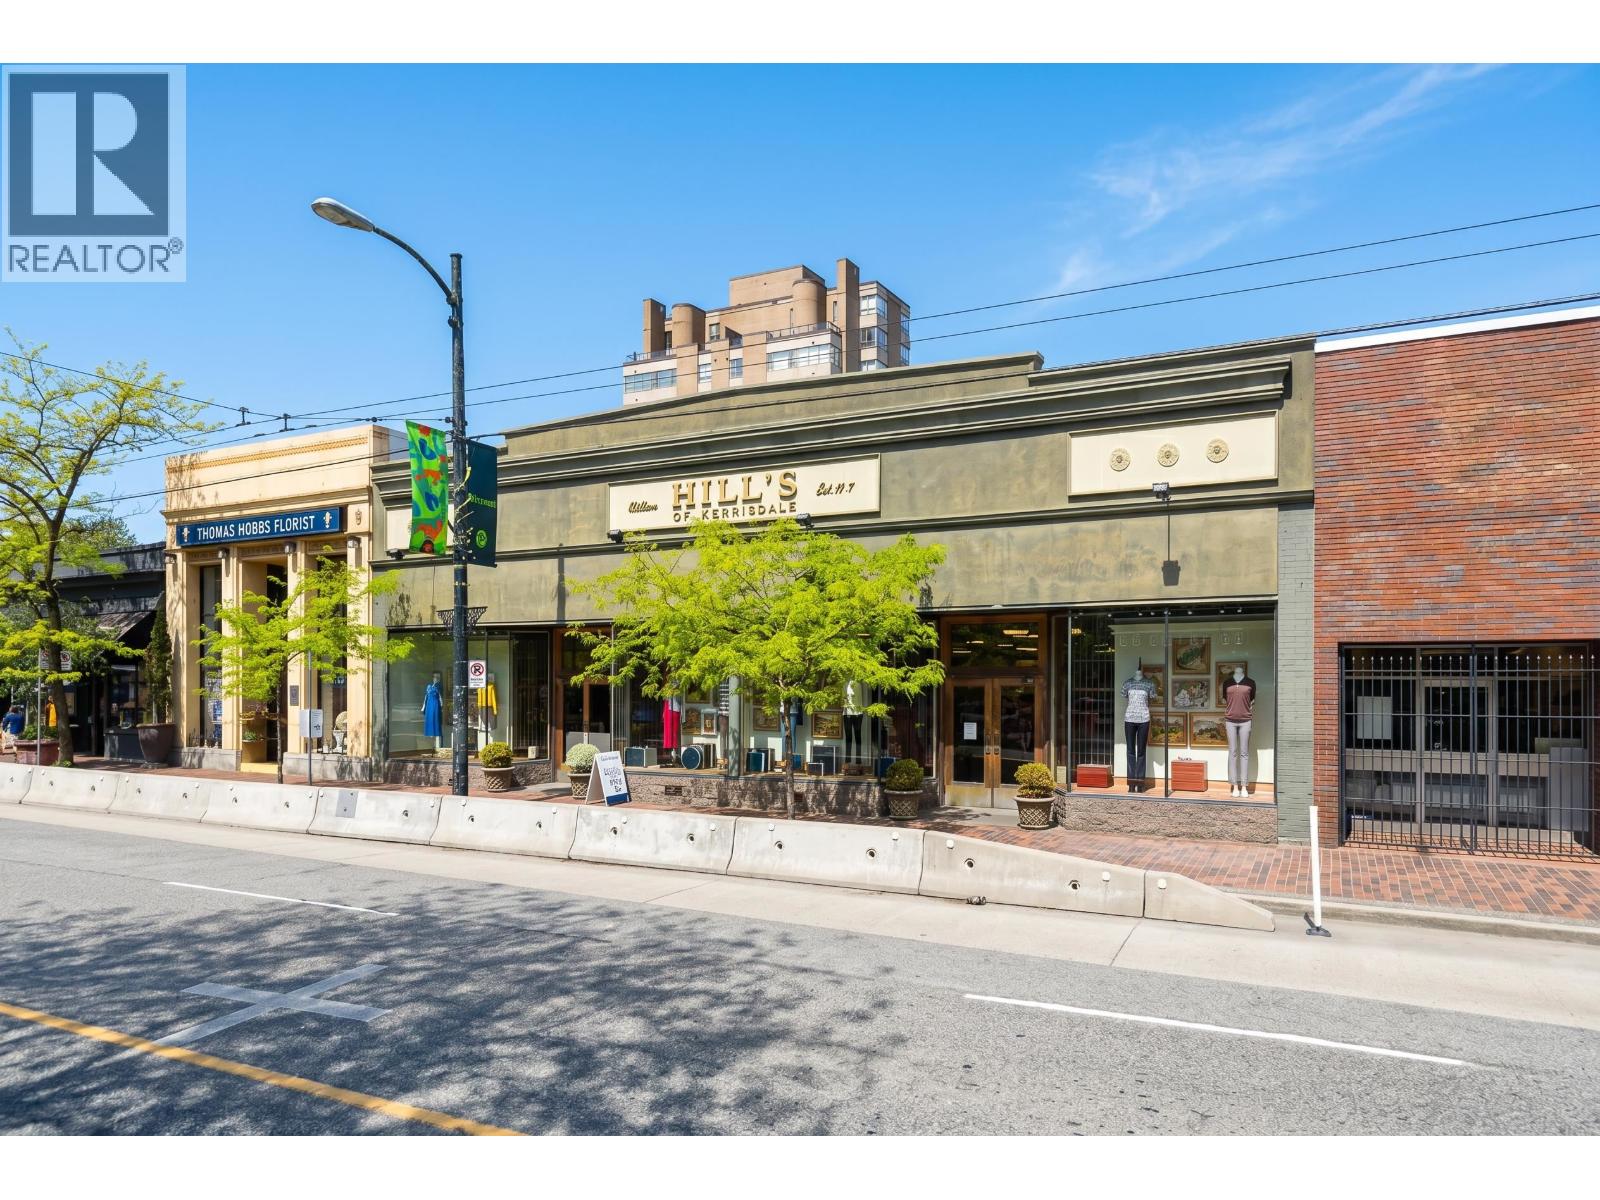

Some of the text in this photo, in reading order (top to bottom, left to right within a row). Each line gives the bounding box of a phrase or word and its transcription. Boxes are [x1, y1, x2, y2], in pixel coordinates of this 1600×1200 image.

[672, 471, 797, 511] HILL'S
[673, 502, 797, 522] OF KERRISDALE
[197, 515, 315, 541] THOMAS HOBBS FLORIST
